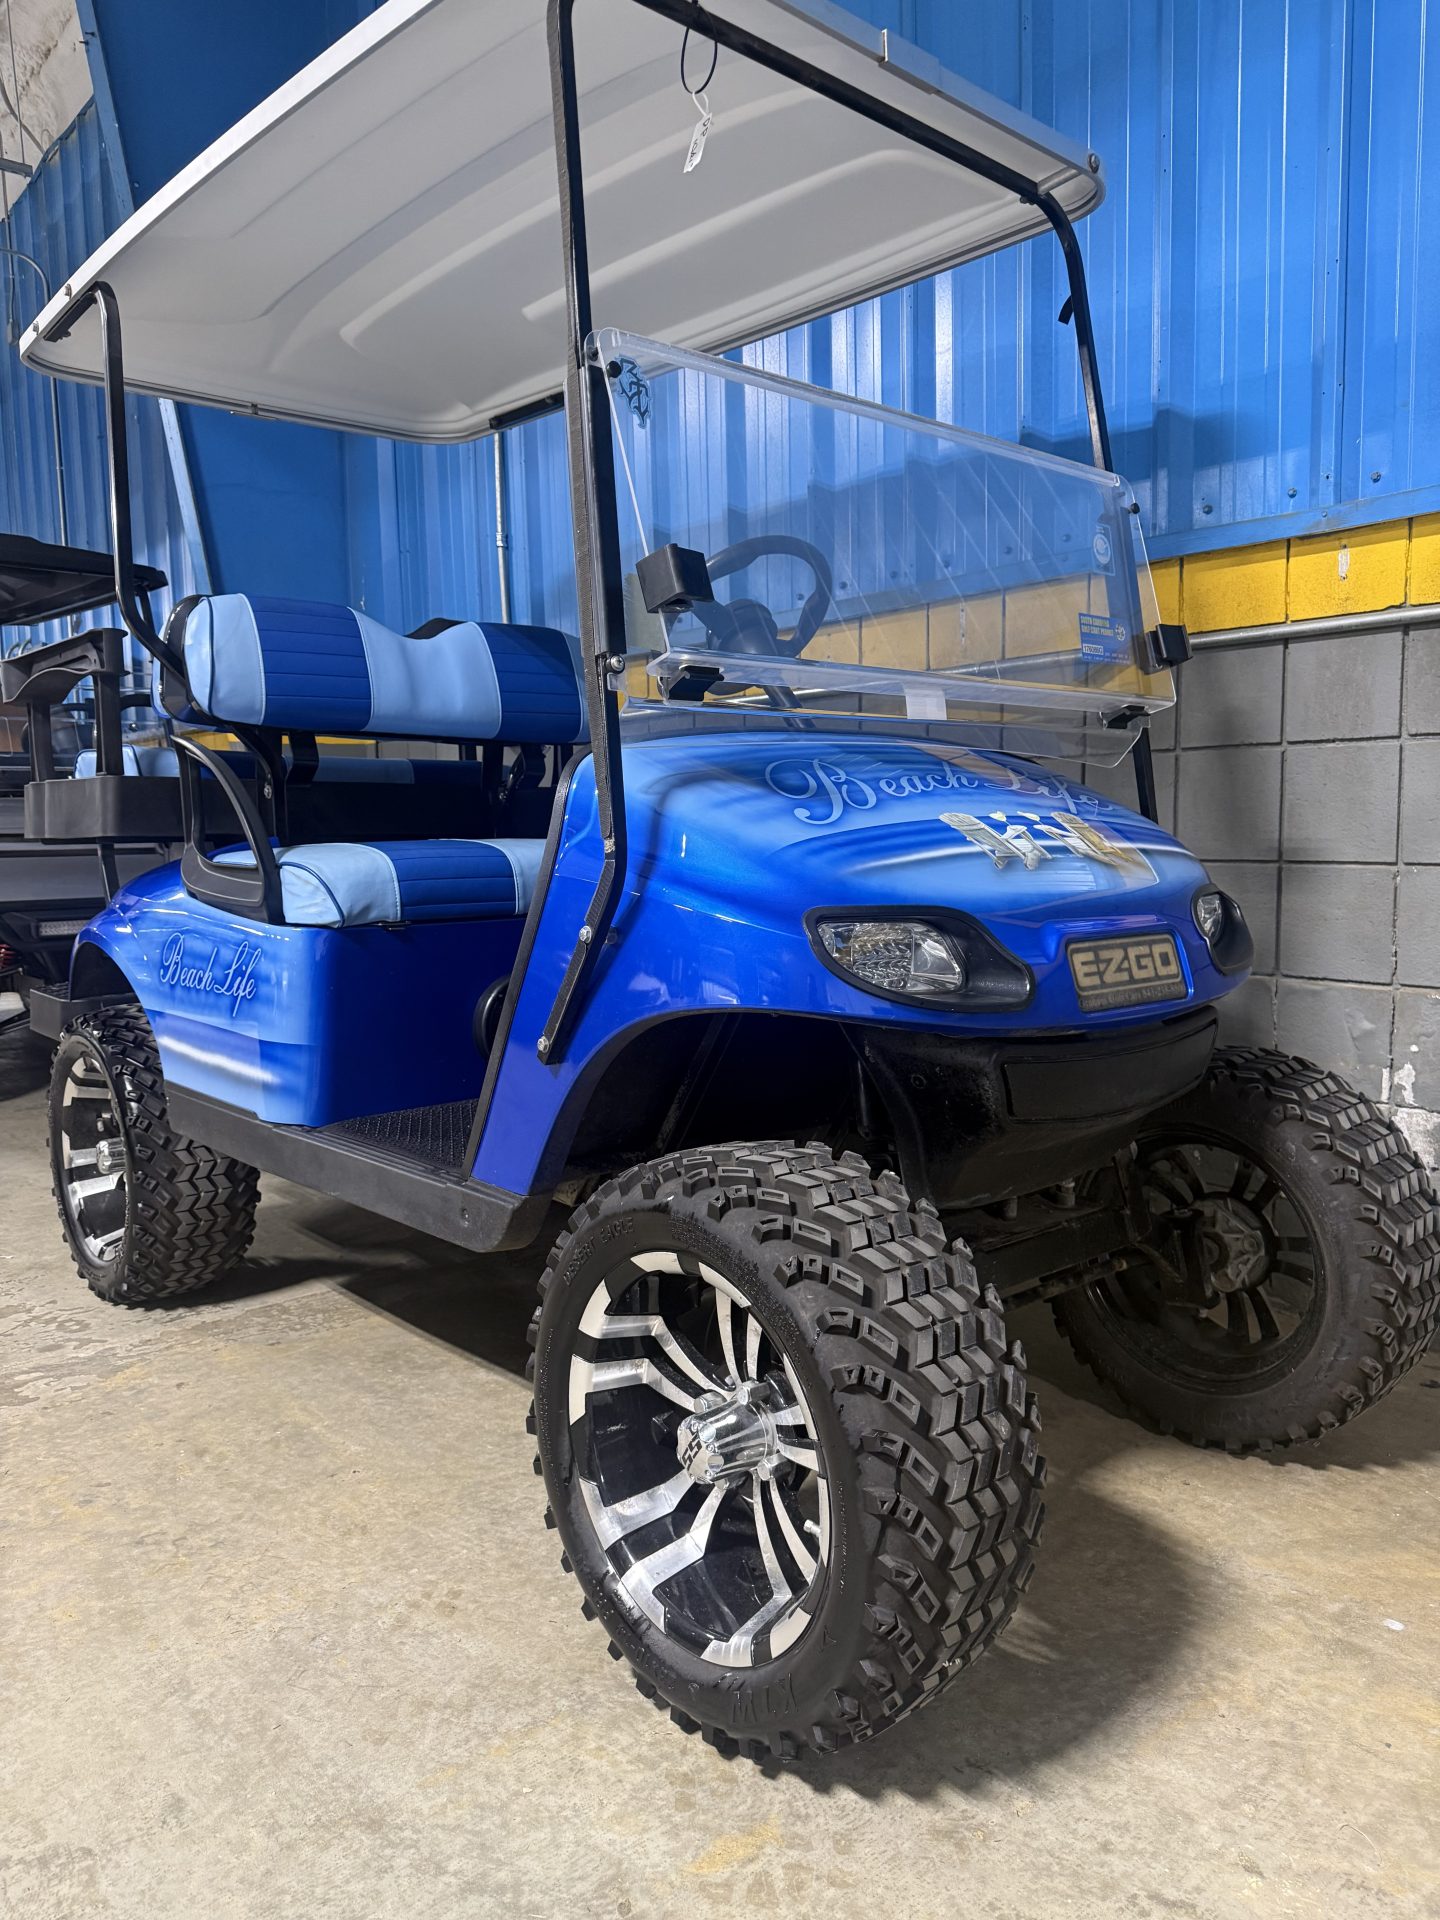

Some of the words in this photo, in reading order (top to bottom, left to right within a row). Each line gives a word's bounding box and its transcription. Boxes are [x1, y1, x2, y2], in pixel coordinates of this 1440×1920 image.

[765, 759, 979, 825] Beach
[984, 766, 1114, 815] Life
[160, 932, 217, 991] Beach
[213, 941, 262, 1017] Life
